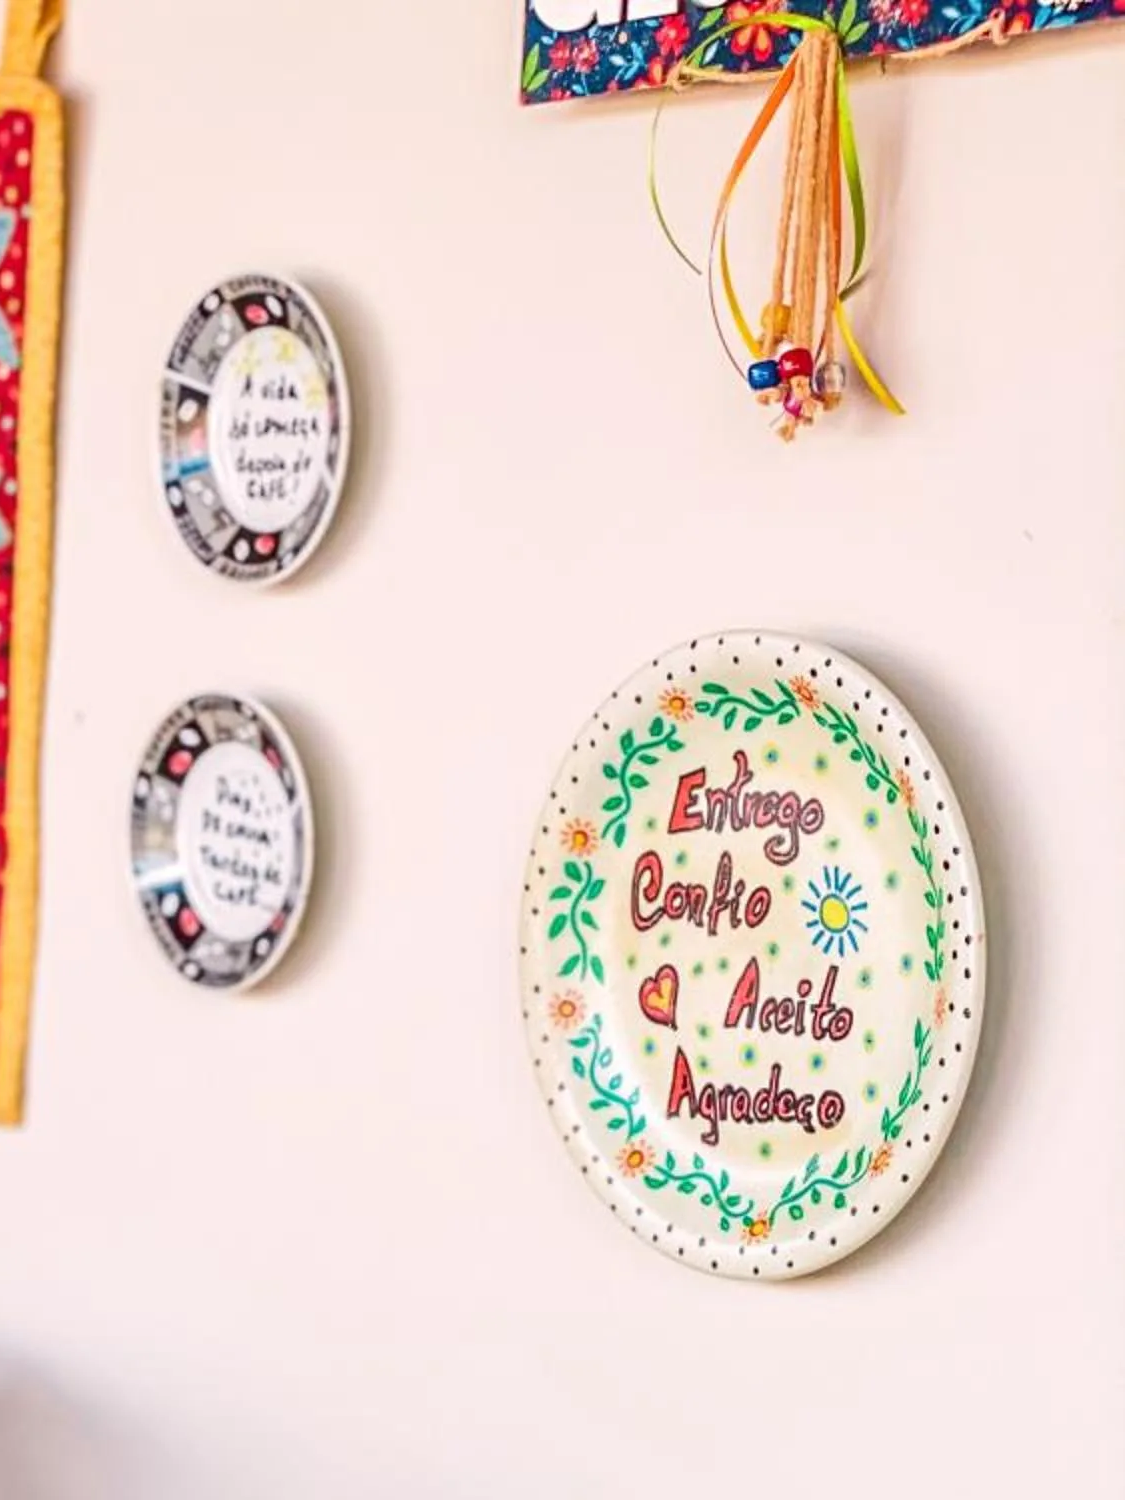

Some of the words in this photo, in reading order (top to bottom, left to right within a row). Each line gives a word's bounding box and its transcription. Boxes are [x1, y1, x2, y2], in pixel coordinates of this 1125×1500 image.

[667, 750, 824, 866] Entrego
[631, 850, 772, 936] Confio
[723, 956, 854, 1041] Aceito
[666, 1046, 845, 1146] Agradeço
